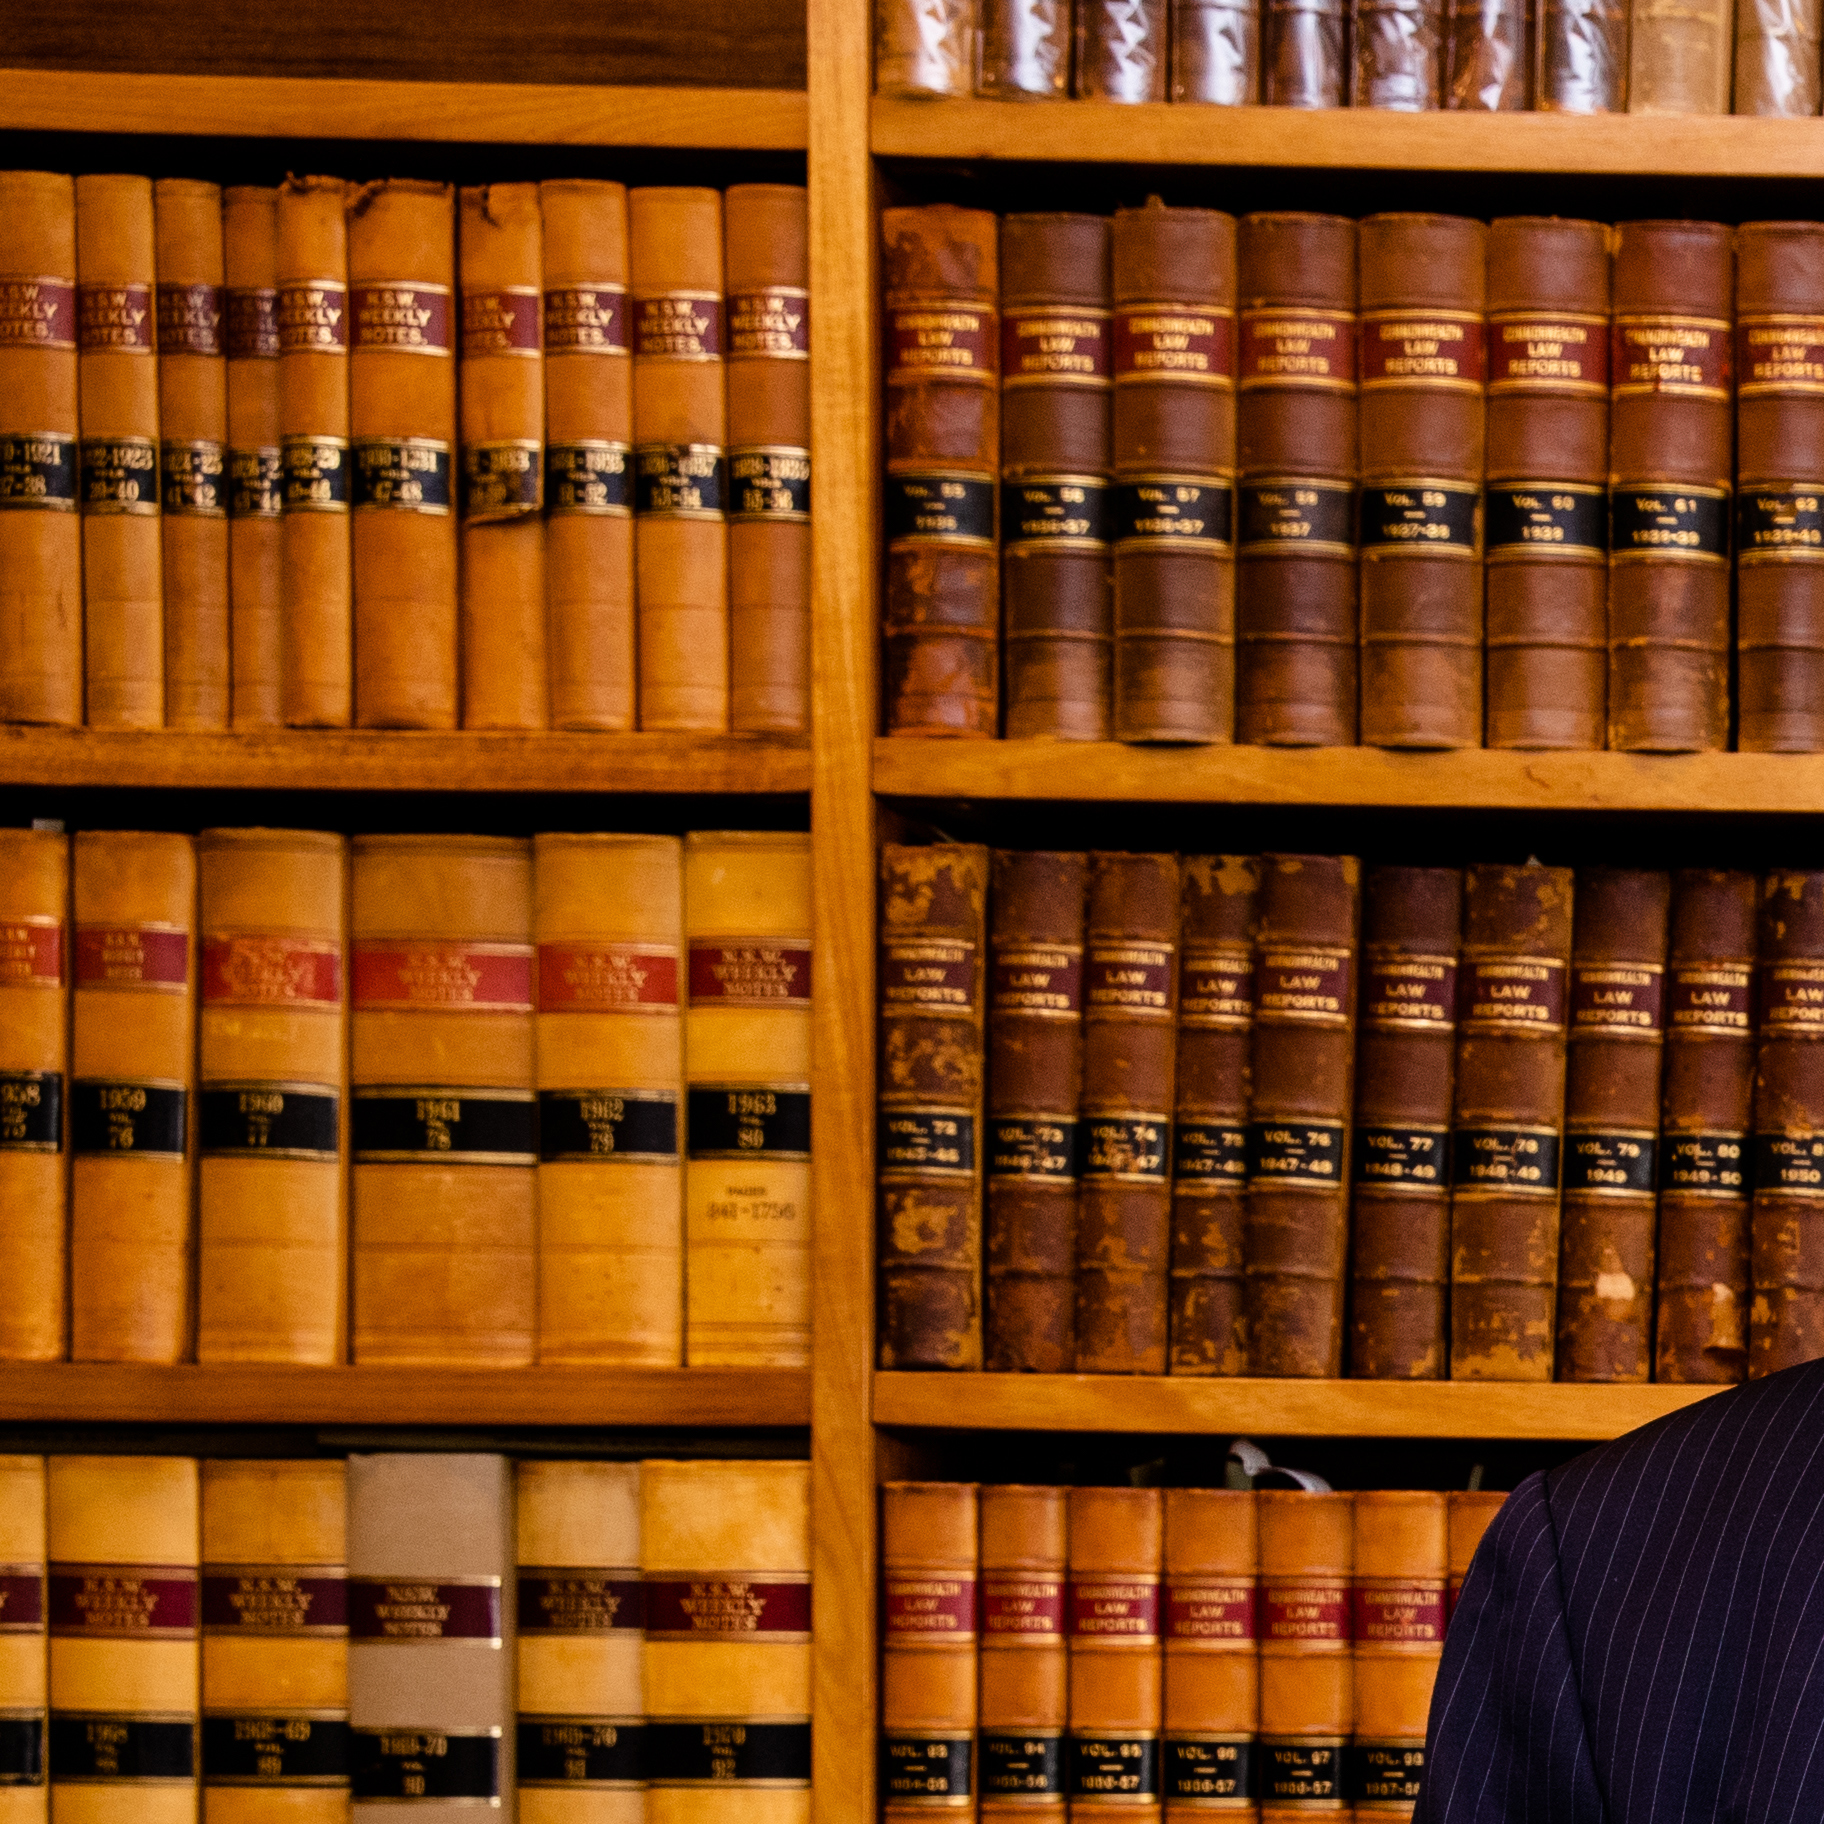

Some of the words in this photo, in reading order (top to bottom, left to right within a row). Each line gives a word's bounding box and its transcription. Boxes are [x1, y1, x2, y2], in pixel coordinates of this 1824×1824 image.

[1404, 341, 1439, 356] LAW
[1528, 343, 1563, 357] LAW
[1649, 349, 1684, 362] LAW
[1385, 358, 1458, 374] REPORTS
[1509, 360, 1581, 377] REPORTS
[904, 968, 947, 982] LAW
[1280, 976, 1321, 989] LAW
[1262, 993, 1339, 1010] REPORTS
[1594, 991, 1633, 1005] LAW
[1577, 1010, 1651, 1026] REPORTS
[1409, 1137, 1433, 1151] 77
[1094, 1601, 1129, 1616] LAW
[1079, 1617, 1148, 1632] REPORTS
